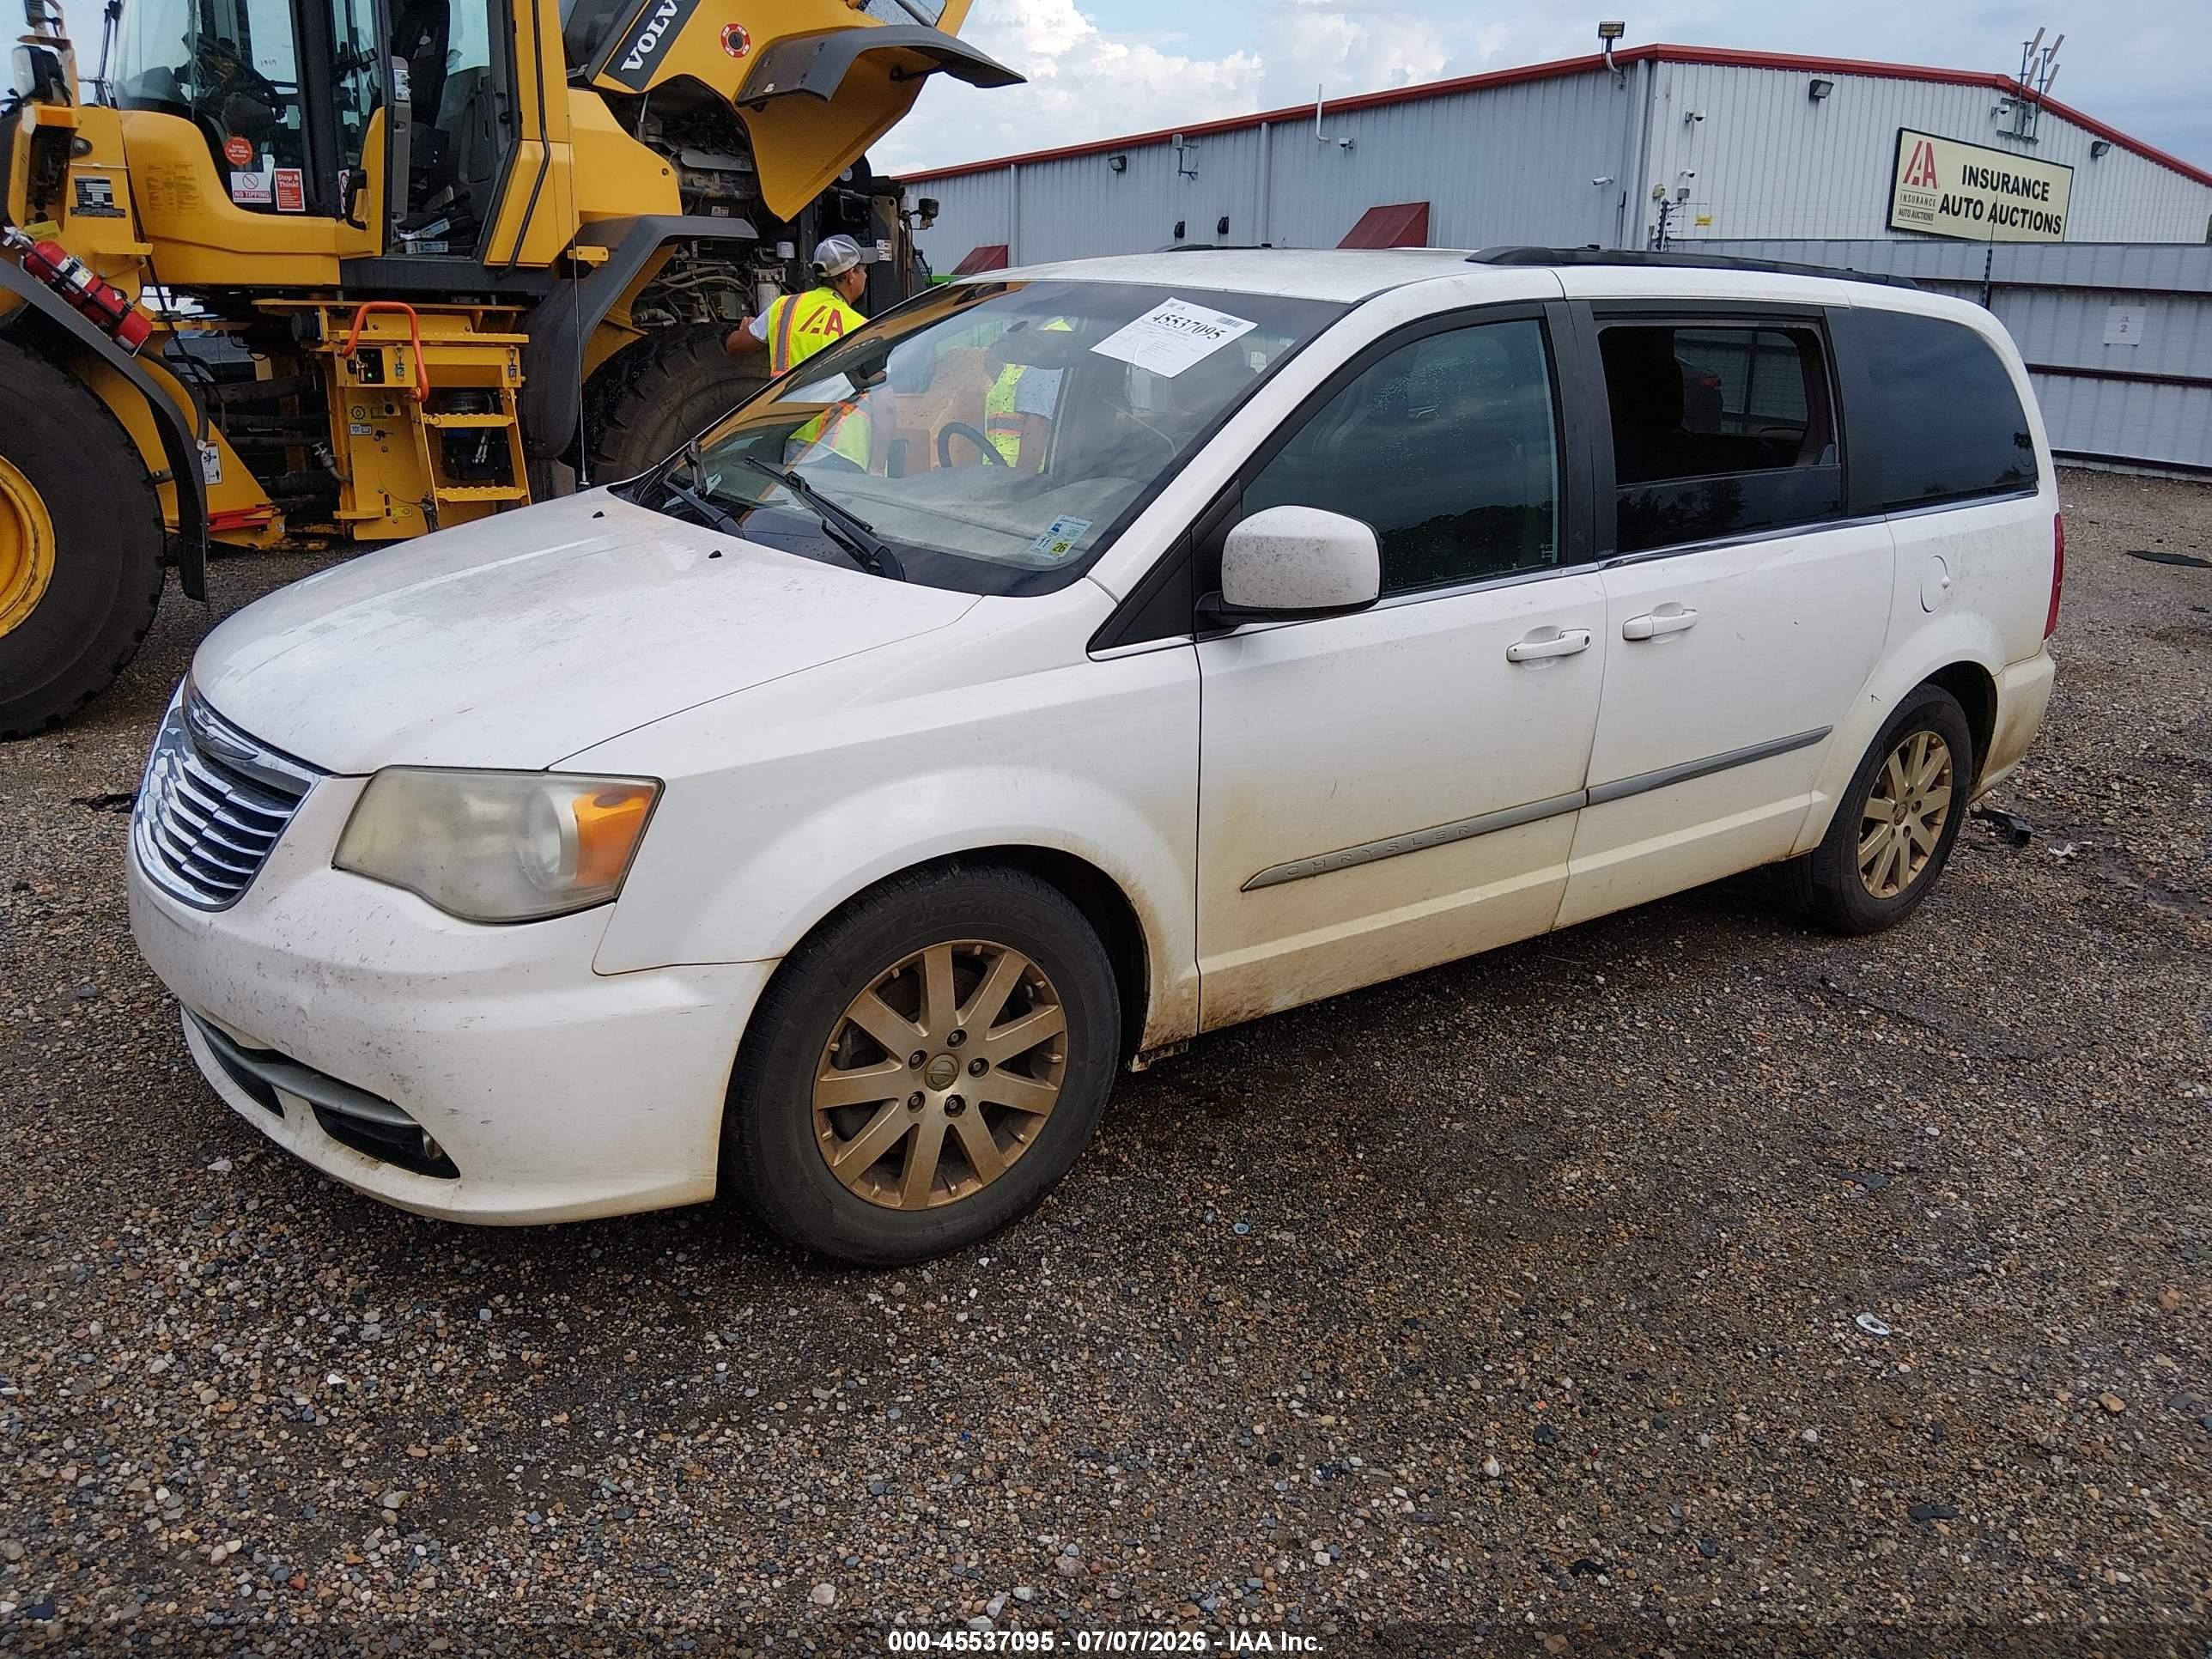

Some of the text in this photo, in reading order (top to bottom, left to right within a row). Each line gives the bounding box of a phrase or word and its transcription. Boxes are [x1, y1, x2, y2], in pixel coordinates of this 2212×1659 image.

[621, 0, 682, 71] VOLV
[1961, 164, 2051, 202] INSURANCE
[1899, 193, 1936, 207] INSURANCE
[1899, 207, 1934, 222] AUTO AUCTIONS
[1938, 193, 2062, 235] AUTO AUCTIONS
[1152, 313, 1226, 340] 45537095
[1037, 537, 1068, 553] 11 26
